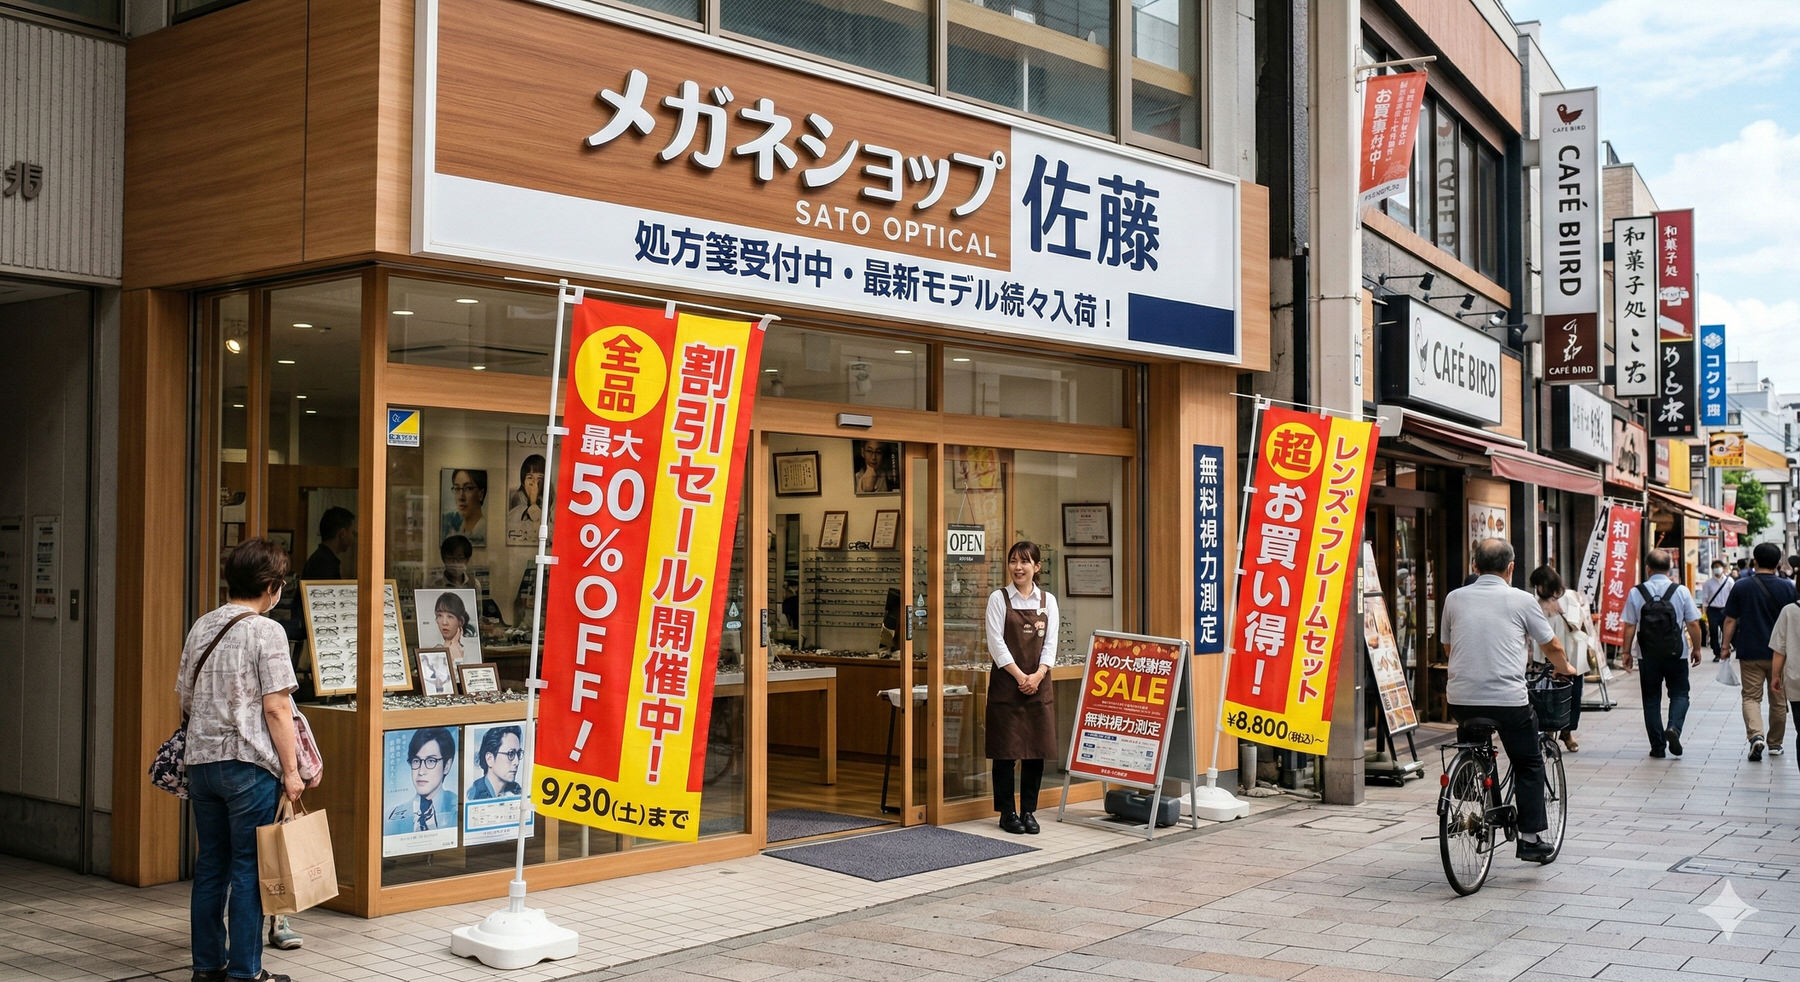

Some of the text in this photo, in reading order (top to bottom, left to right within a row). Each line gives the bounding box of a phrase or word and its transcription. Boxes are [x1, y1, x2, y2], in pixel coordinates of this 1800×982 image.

[584, 68, 1007, 218] メガネショップ
[1558, 145, 1588, 213] CAFÉ
[795, 200, 997, 259] SATO OPTICAL
[1021, 153, 1160, 272] 佐藤
[1664, 225, 1679, 277] 和菓子処
[596, 333, 643, 414] 全品
[1433, 341, 1497, 399] CAFÉ BIRD
[1548, 365, 1594, 375] CAFÉ BIRD
[580, 424, 644, 462] 最大
[1271, 429, 1315, 474] 超
[637, 342, 737, 785] 割引セール開催中！
[949, 533, 983, 552] OPEN
[1199, 454, 1218, 645] 無料視力測定
[1297, 436, 1360, 704] レンズ・フレームセット
[1607, 520, 1630, 598] 和菓子処
[1244, 482, 1307, 697] お買い得！
[1090, 670, 1168, 705] SALE
[1095, 652, 1173, 676] 秋の大感謝祭
[1084, 711, 1162, 737] 無料視力測定
[540, 777, 690, 830] 9/30(土)まで
